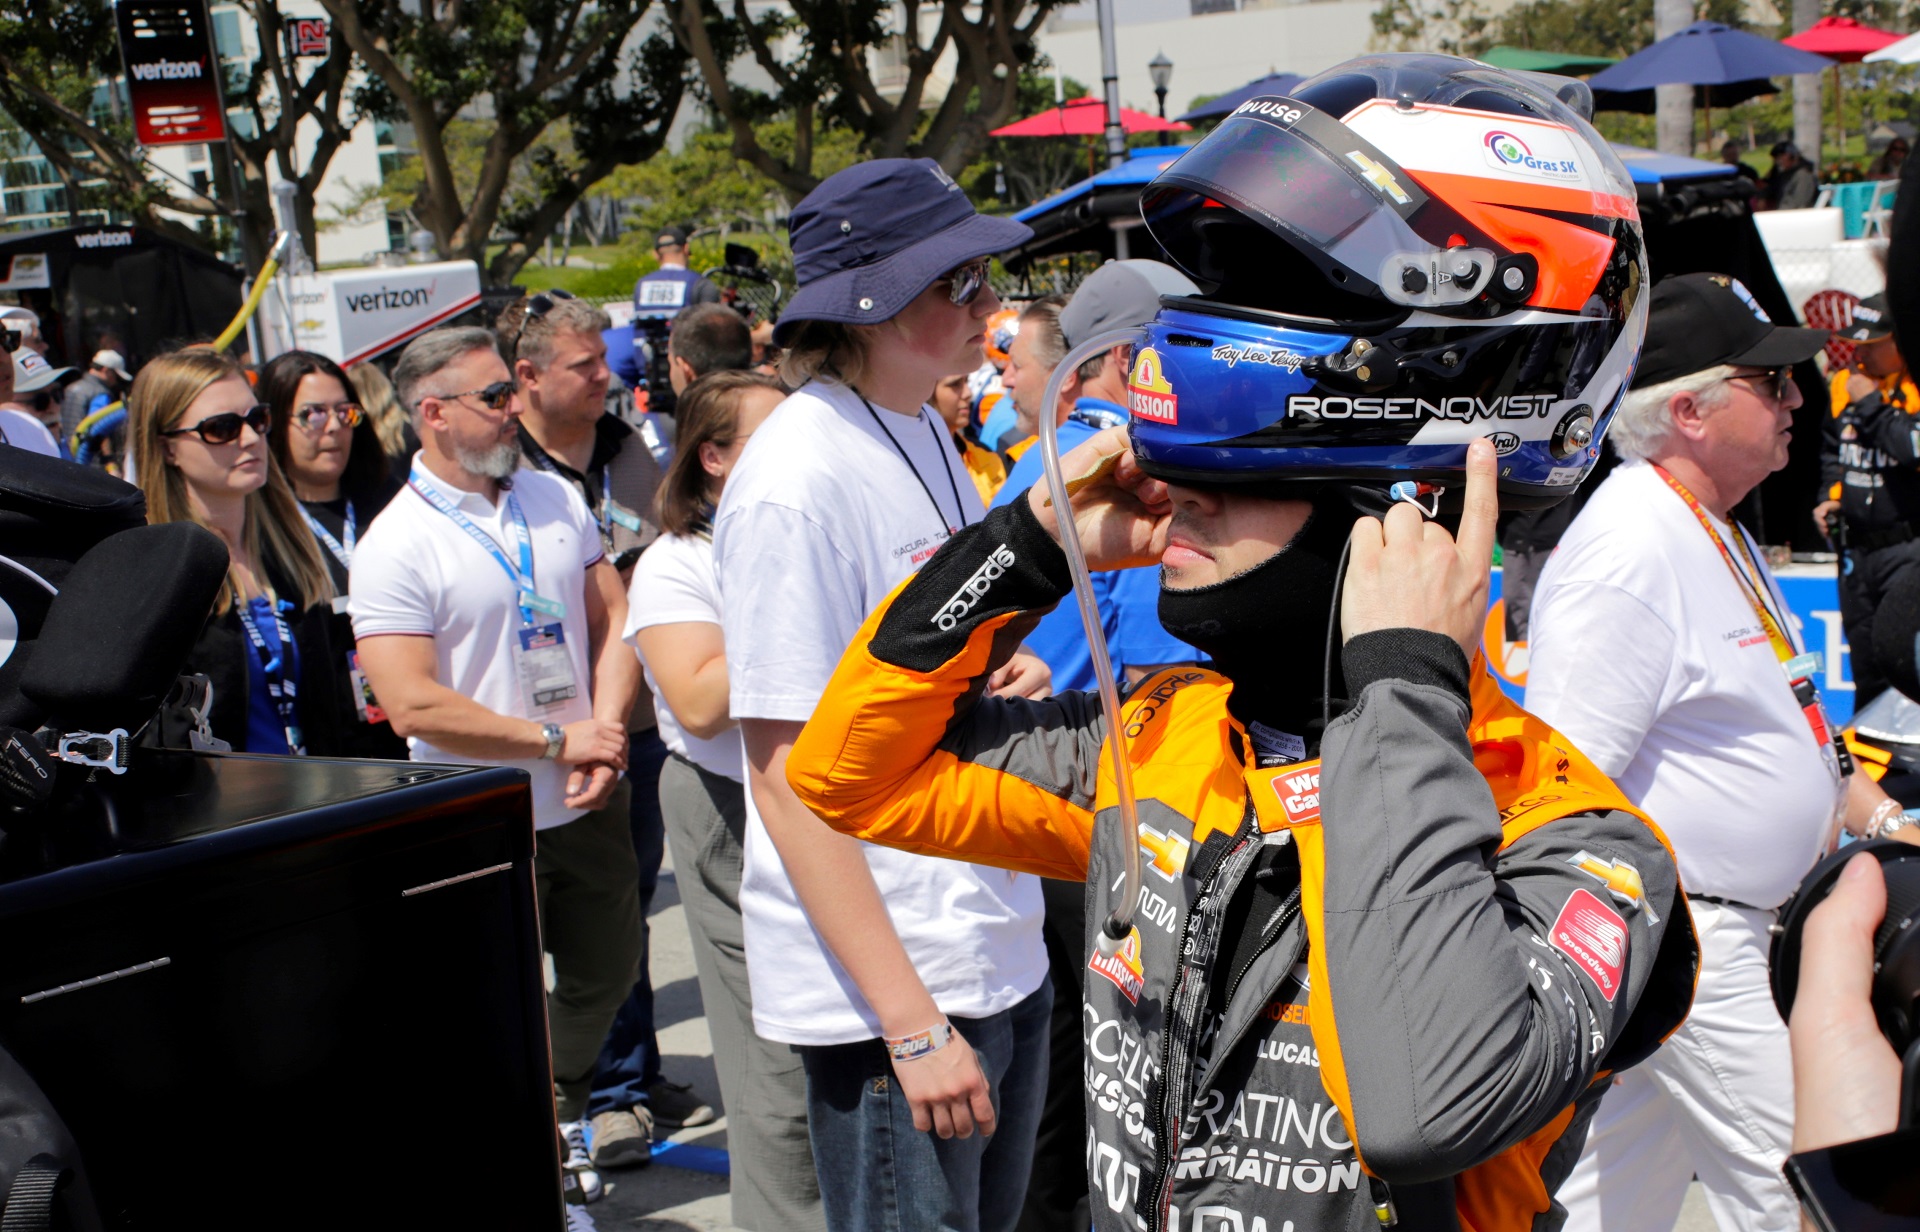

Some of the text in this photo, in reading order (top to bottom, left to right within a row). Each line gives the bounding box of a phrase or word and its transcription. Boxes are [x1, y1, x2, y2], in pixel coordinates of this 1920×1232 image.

[131, 58, 202, 80] verizon
[1524, 156, 1577, 173] Gras SK
[75, 229, 132, 248] verizon
[346, 286, 428, 312] verizon
[1212, 344, 1241, 368] Troy
[1242, 347, 1268, 362] Lee
[1288, 394, 1558, 421] ROSENQVIST
[1669, 476, 1696, 504] THE
[901, 537, 930, 556] ACURA
[931, 543, 1015, 631] sparco
[1125, 672, 1204, 738] sparco
[5, 736, 48, 779] ZERO
[1285, 793, 1320, 814] Ca
[1559, 930, 1613, 990] Speedway
